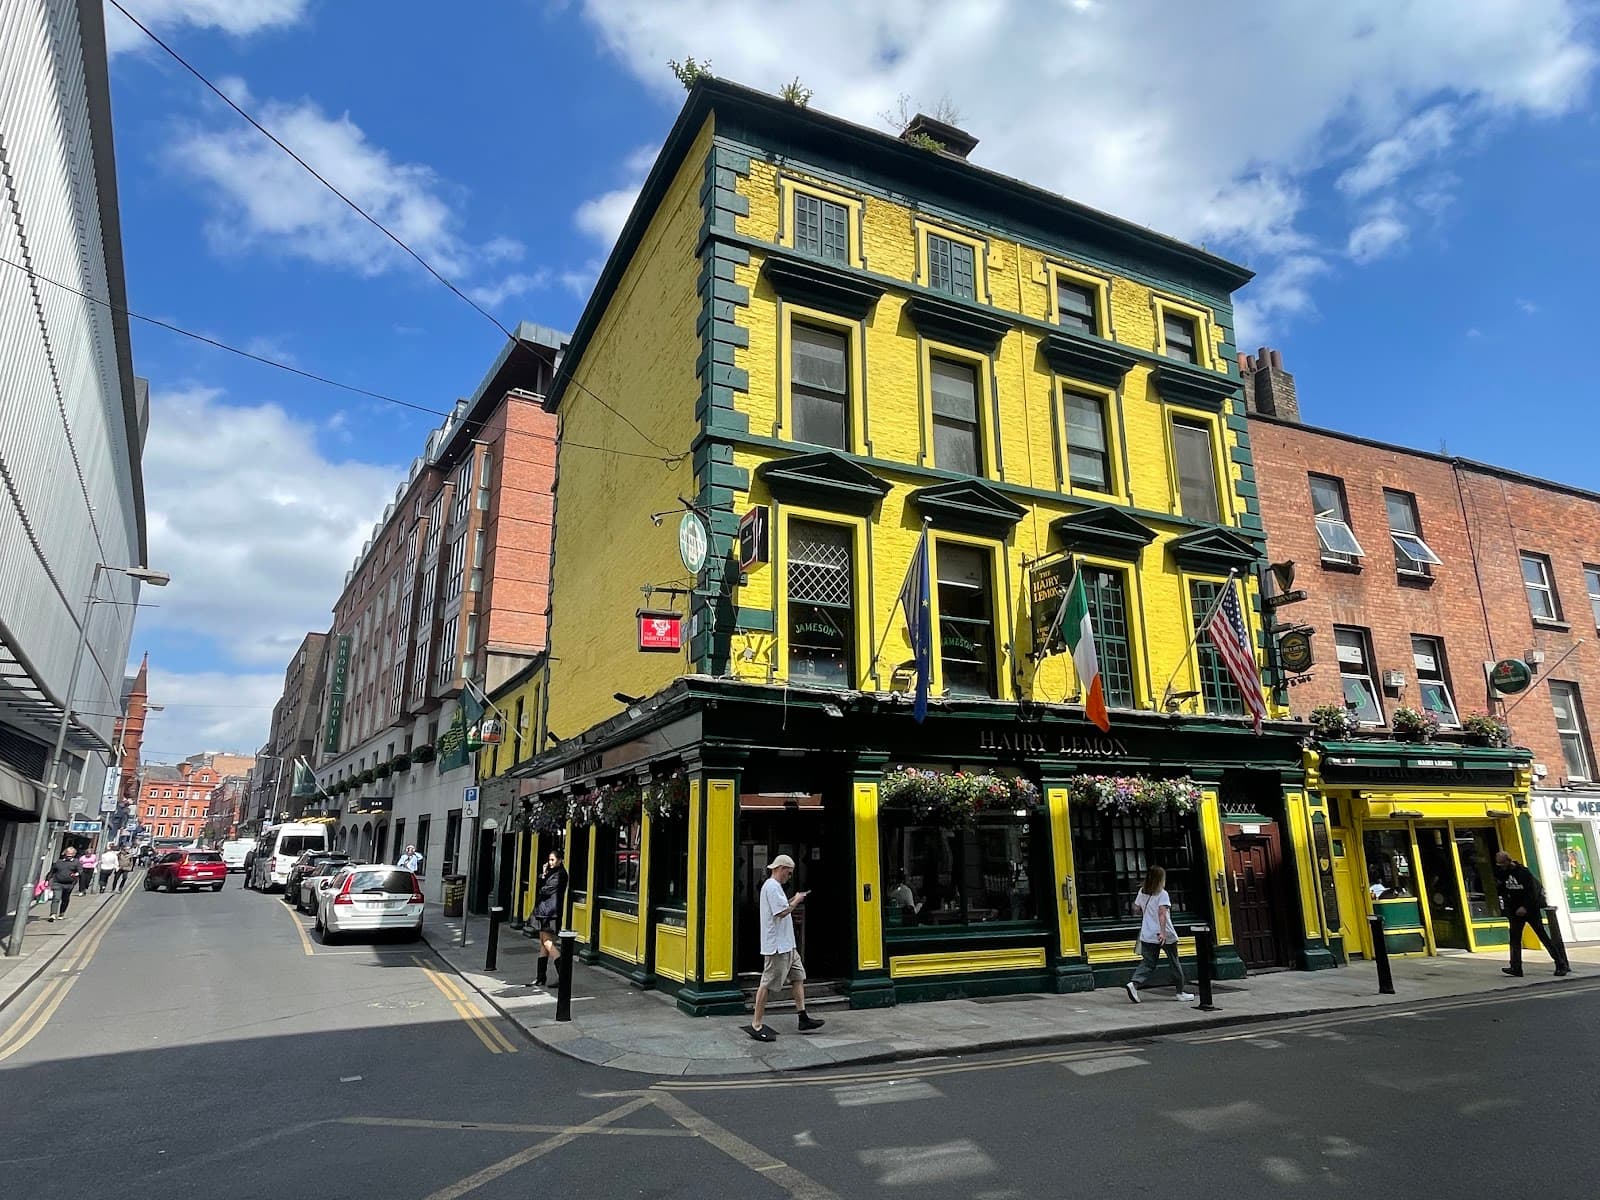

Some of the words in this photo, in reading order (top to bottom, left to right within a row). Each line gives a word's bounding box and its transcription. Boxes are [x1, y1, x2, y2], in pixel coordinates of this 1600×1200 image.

[1033, 574, 1060, 593] HAIRY
[795, 622, 836, 637] JAMESON
[335, 640, 347, 692] BROOKS
[980, 730, 1047, 752] HAIRY
[1060, 735, 1128, 756] LEMON
[468, 790, 475, 800] P
